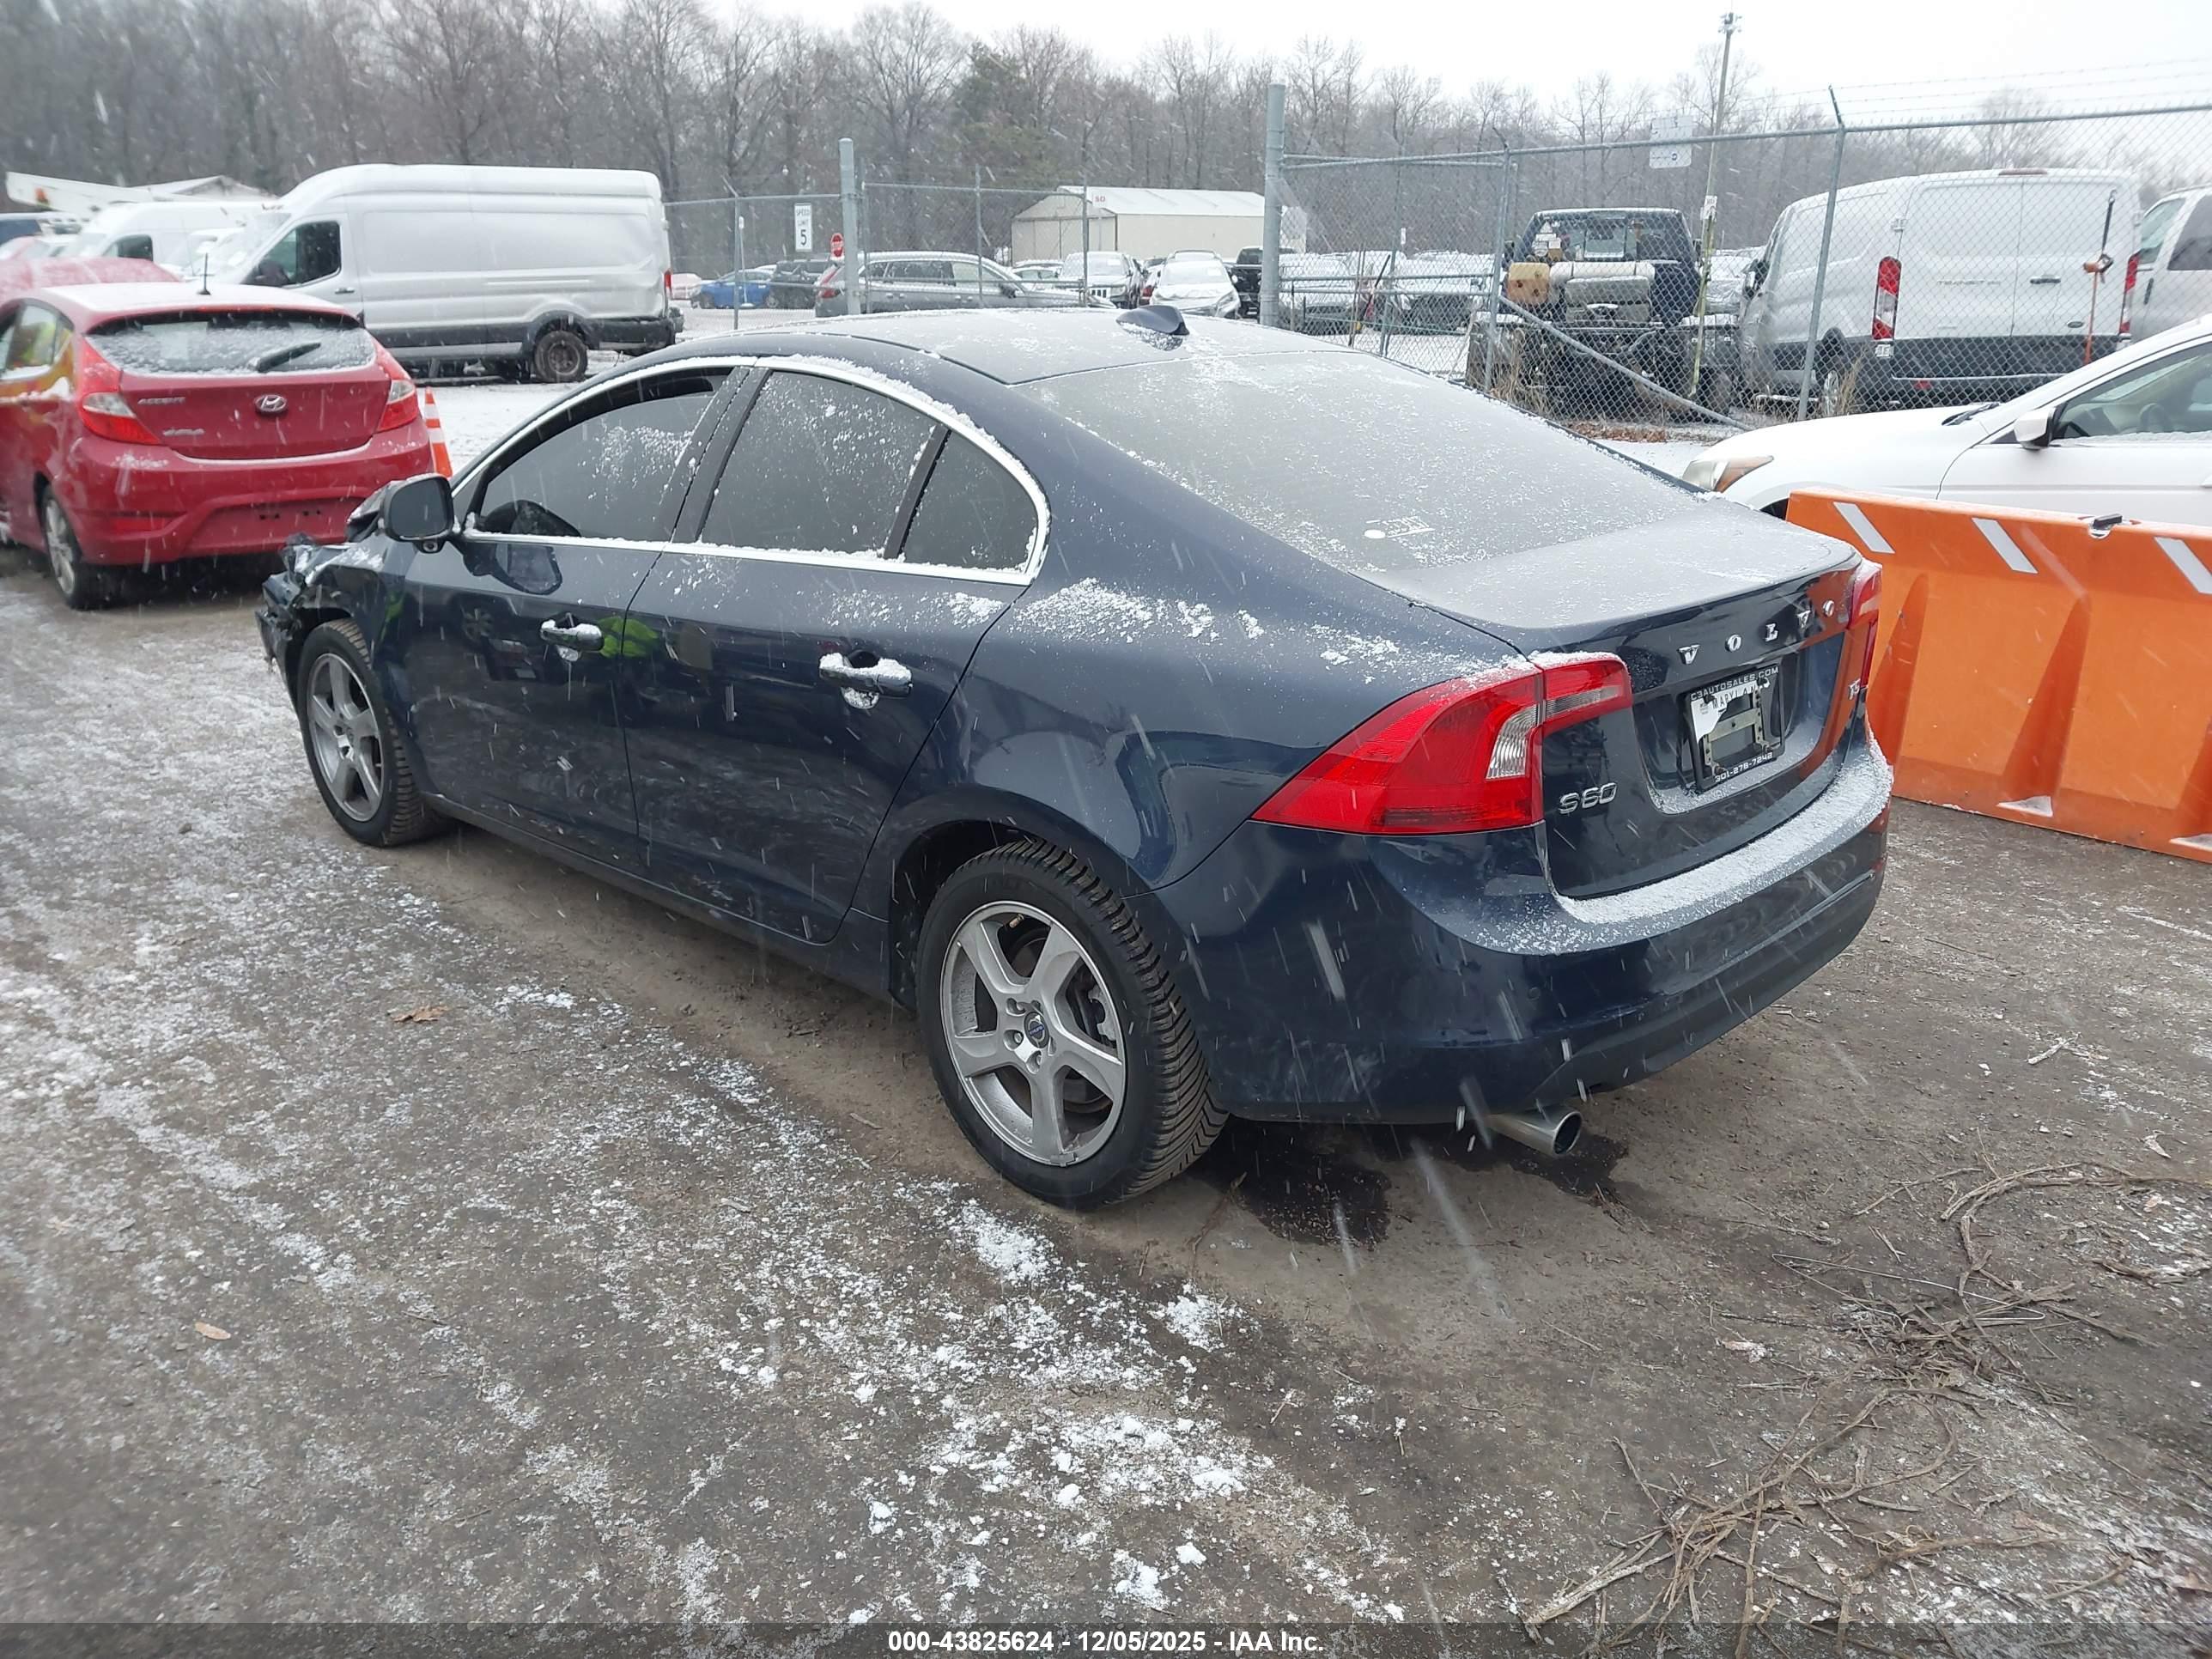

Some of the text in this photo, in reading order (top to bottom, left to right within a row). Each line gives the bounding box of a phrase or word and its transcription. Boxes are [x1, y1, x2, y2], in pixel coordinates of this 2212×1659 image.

[800, 228, 807, 246] 5
[1677, 599, 1835, 665] VOLVO
[1690, 666, 1779, 702] C3AUTOSALES.COM
[1557, 781, 1618, 815] S60
